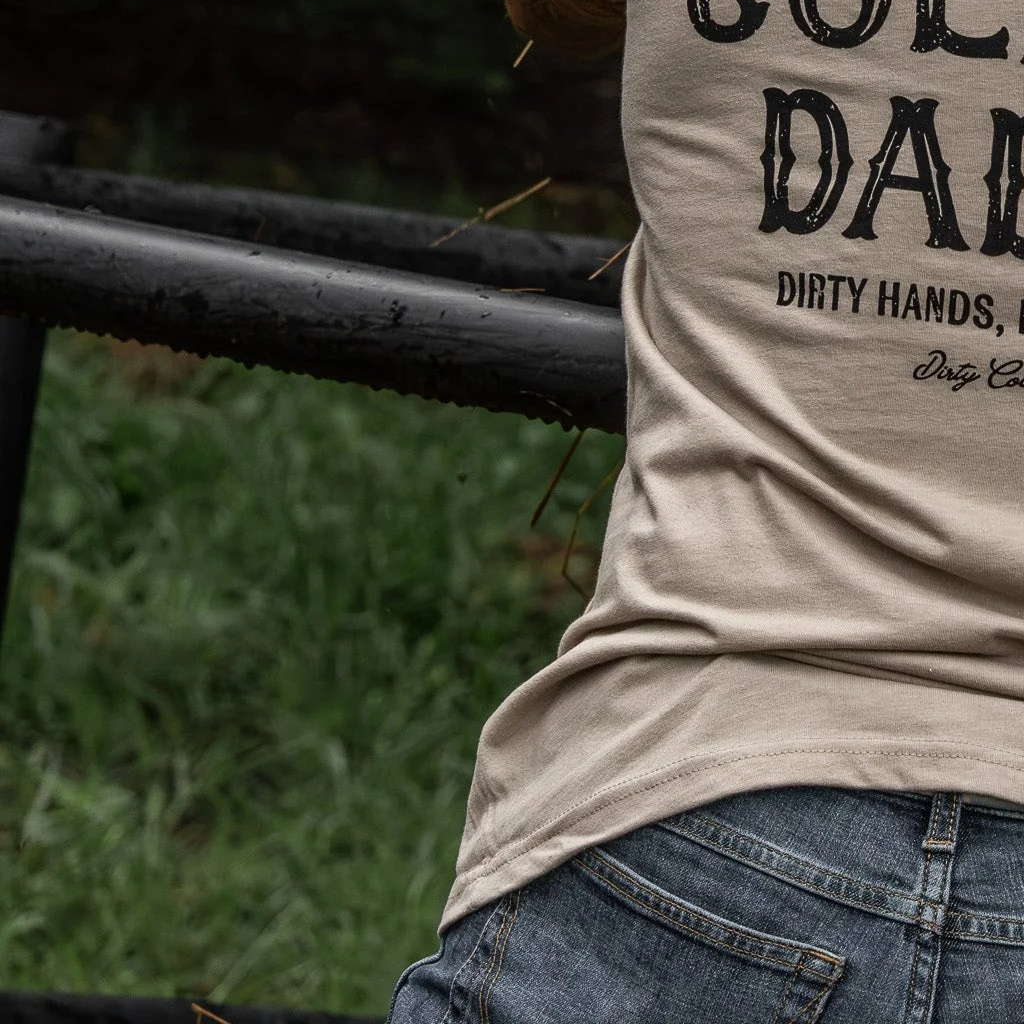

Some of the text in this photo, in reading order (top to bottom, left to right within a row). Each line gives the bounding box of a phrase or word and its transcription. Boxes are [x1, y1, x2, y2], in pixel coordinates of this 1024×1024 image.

[776, 270, 868, 314] DIRTY
[877, 279, 1005, 338] HANDS,
[912, 349, 982, 393] Dirty
